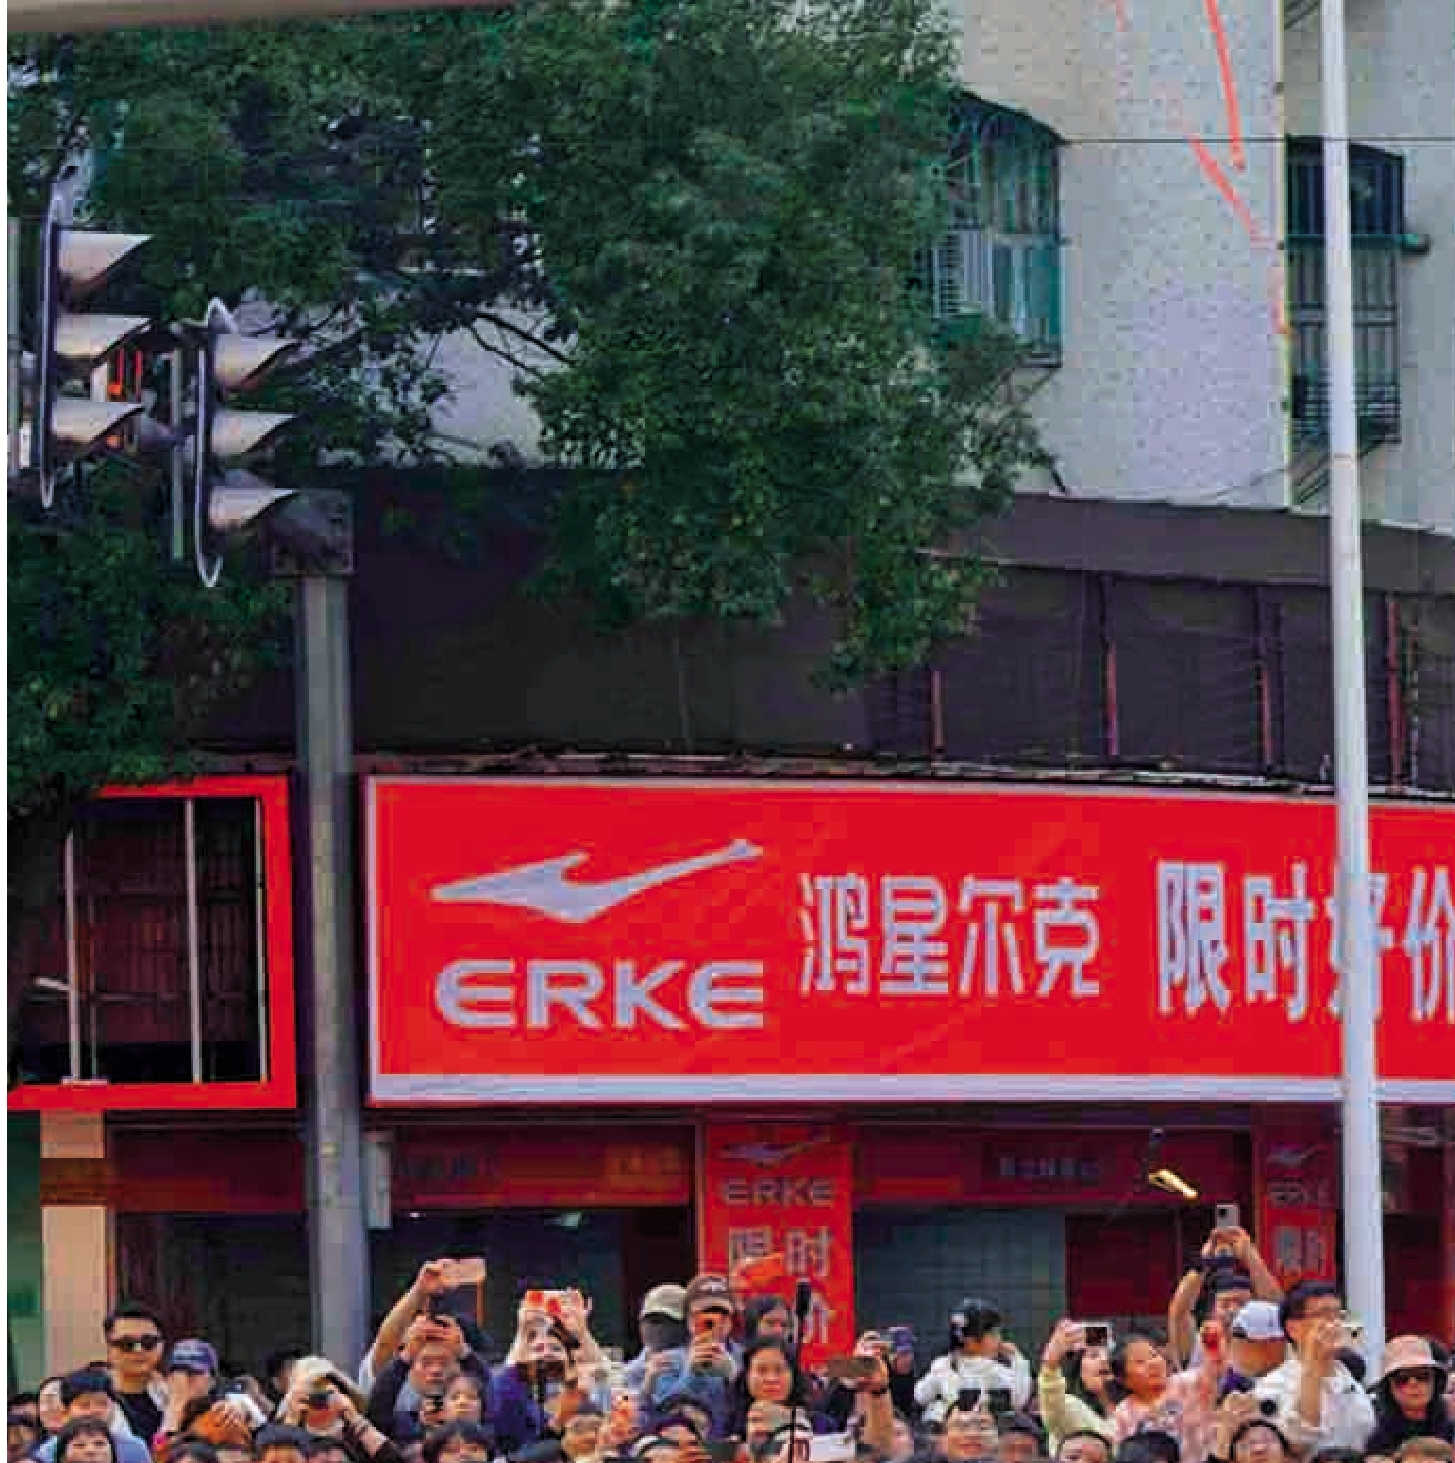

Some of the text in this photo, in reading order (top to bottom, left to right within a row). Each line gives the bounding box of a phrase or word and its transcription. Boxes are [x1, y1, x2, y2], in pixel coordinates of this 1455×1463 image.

[798, 872, 1100, 998] 鸿星尔克
[434, 958, 764, 1029] ERKE
[718, 1176, 835, 1207] ERKE
